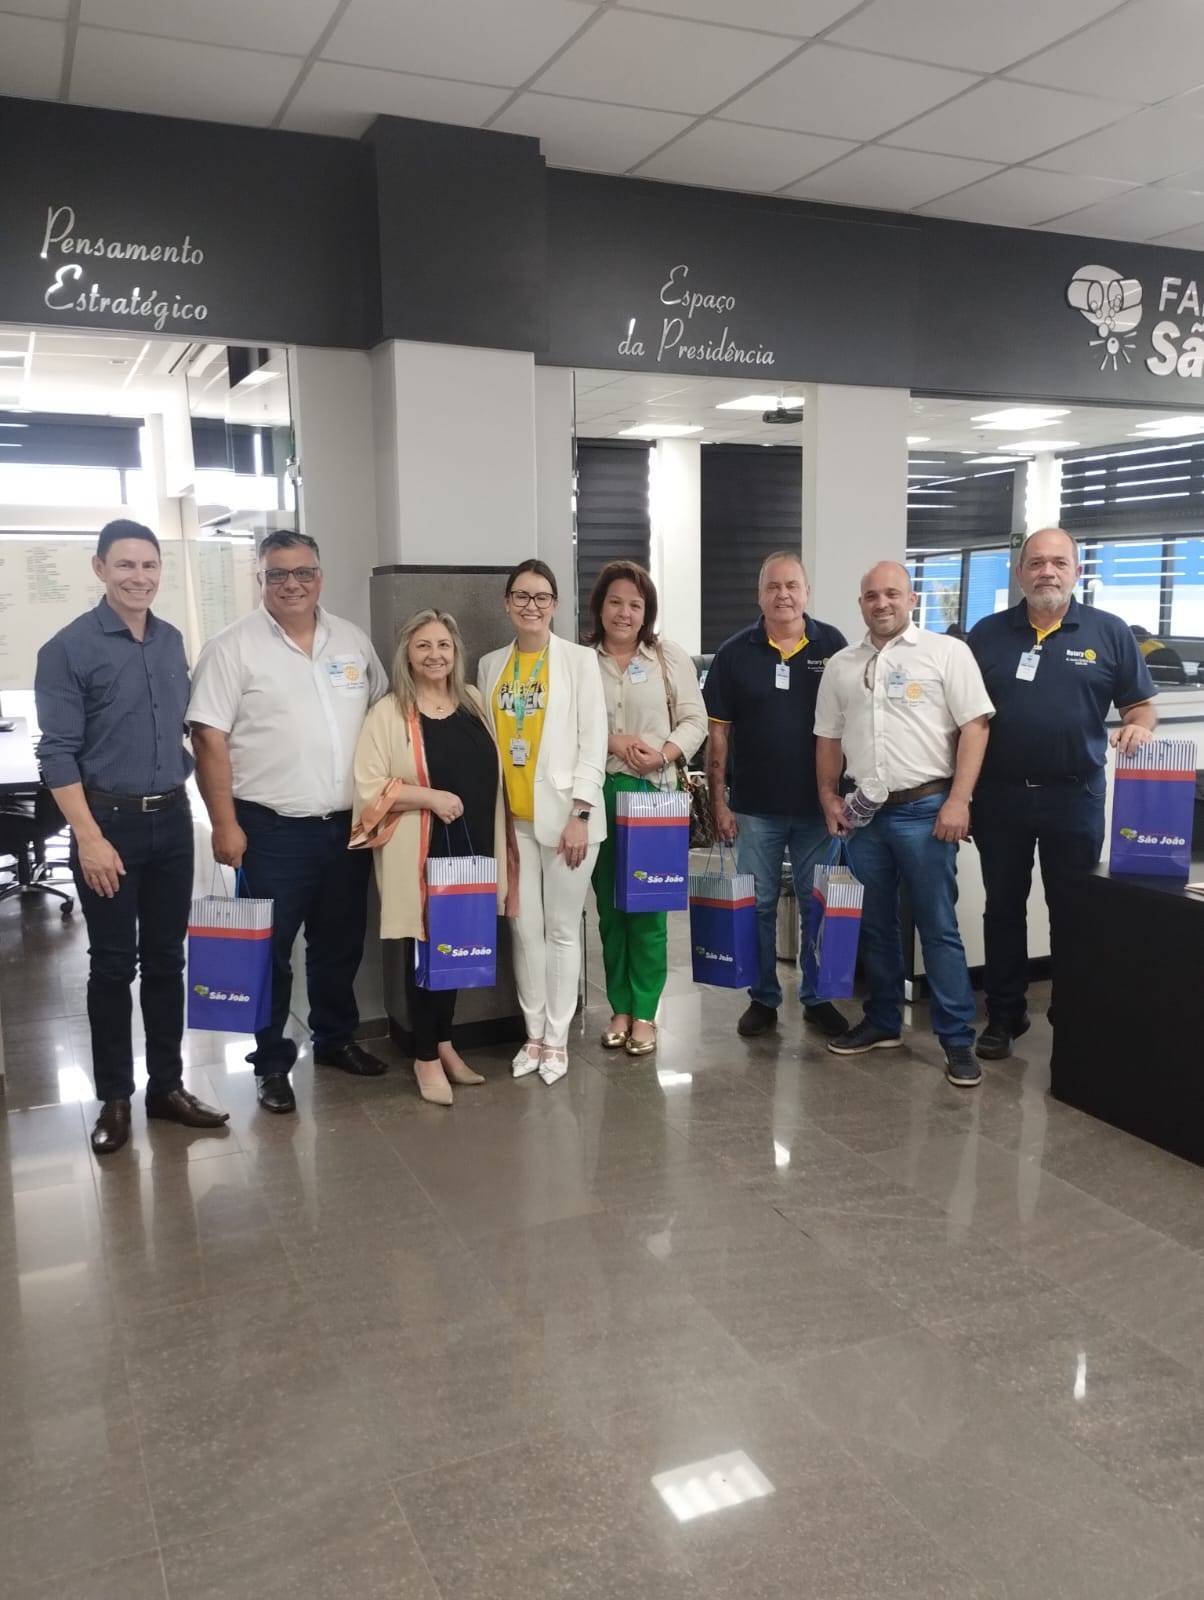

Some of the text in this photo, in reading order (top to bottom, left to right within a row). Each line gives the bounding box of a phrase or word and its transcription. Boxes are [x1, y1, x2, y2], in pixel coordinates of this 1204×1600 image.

[40, 205, 204, 265] Pensamento
[44, 264, 208, 331] Estratégico
[659, 264, 736, 319] Espaço
[1158, 276, 1204, 317] FA
[617, 317, 776, 366] da Presidência
[1137, 834, 1186, 845] São João
[452, 946, 492, 957] São João
[208, 991, 250, 1002] São João
